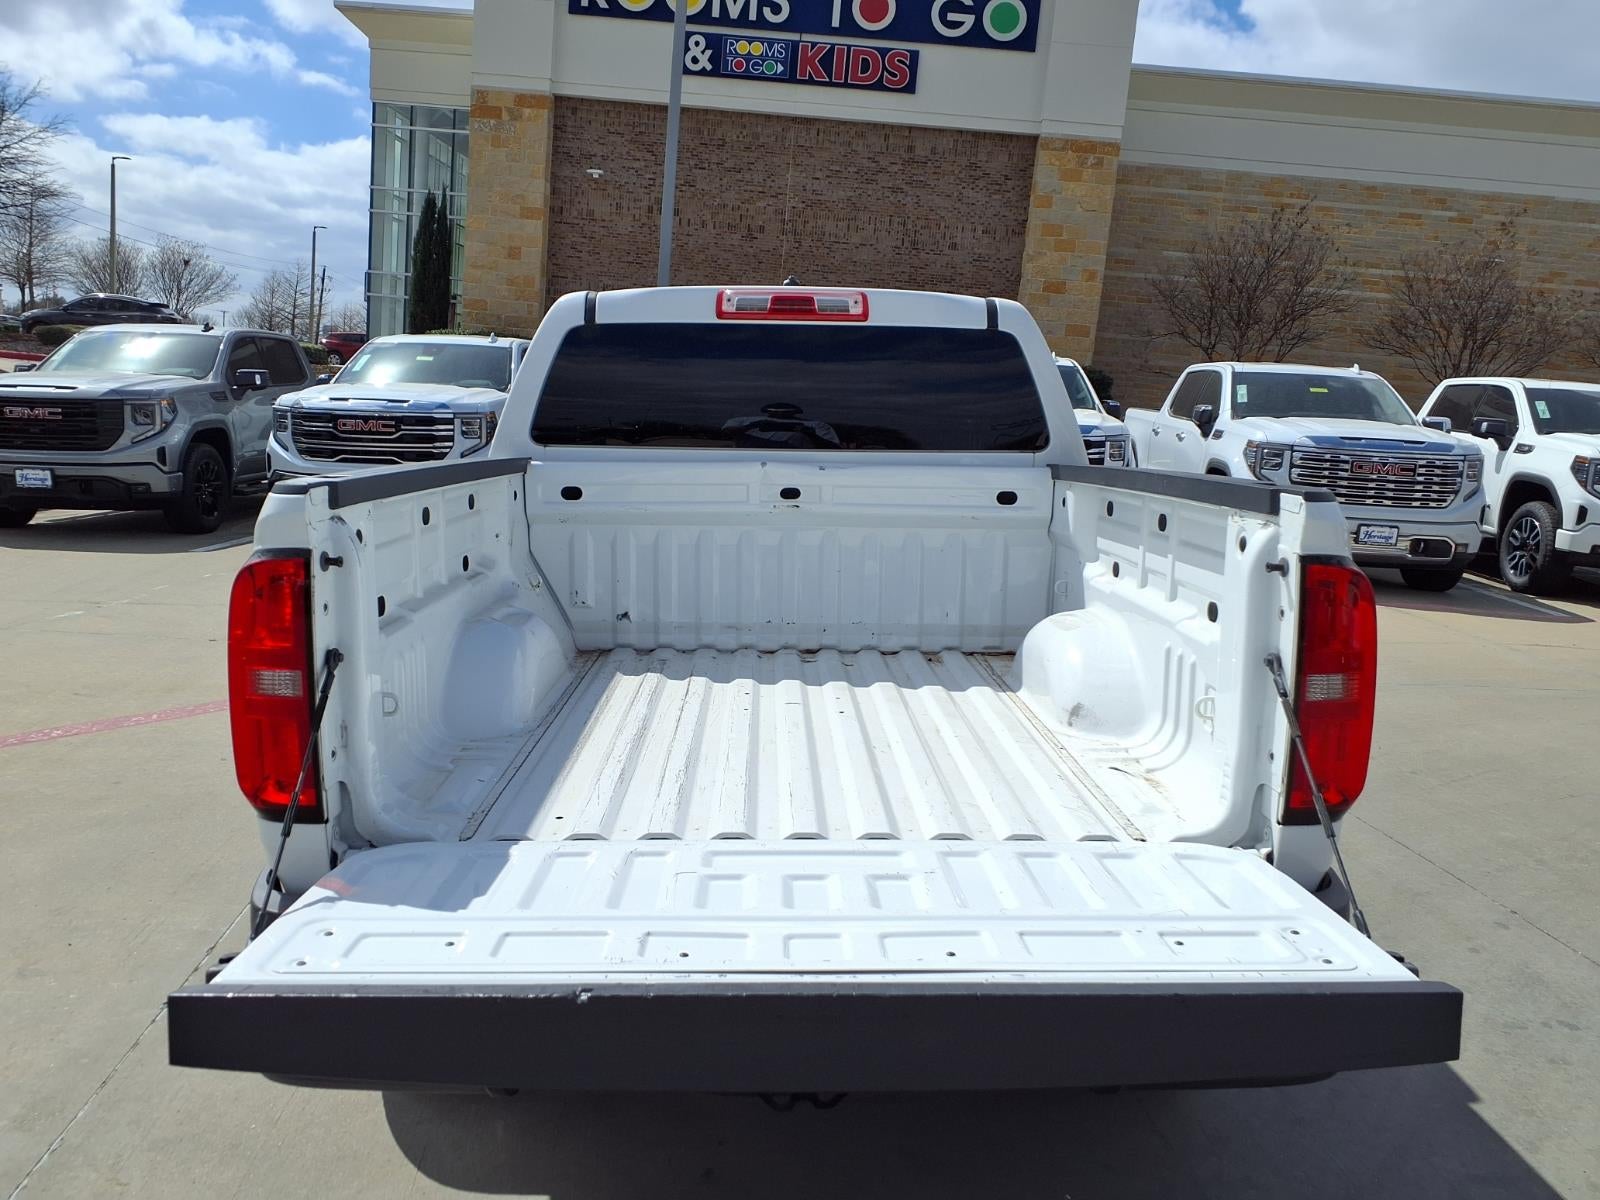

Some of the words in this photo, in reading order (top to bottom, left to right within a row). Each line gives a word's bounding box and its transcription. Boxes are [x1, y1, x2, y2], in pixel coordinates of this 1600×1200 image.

[930, 0, 1028, 42] GO
[684, 34, 713, 72] &
[726, 39, 786, 58] ROOMS
[726, 56, 746, 72] TO
[749, 59, 777, 75] GO
[796, 42, 911, 88] KIDS
[3, 406, 62, 420] GMC
[337, 419, 396, 432] GMC
[1353, 461, 1416, 476] GMC
